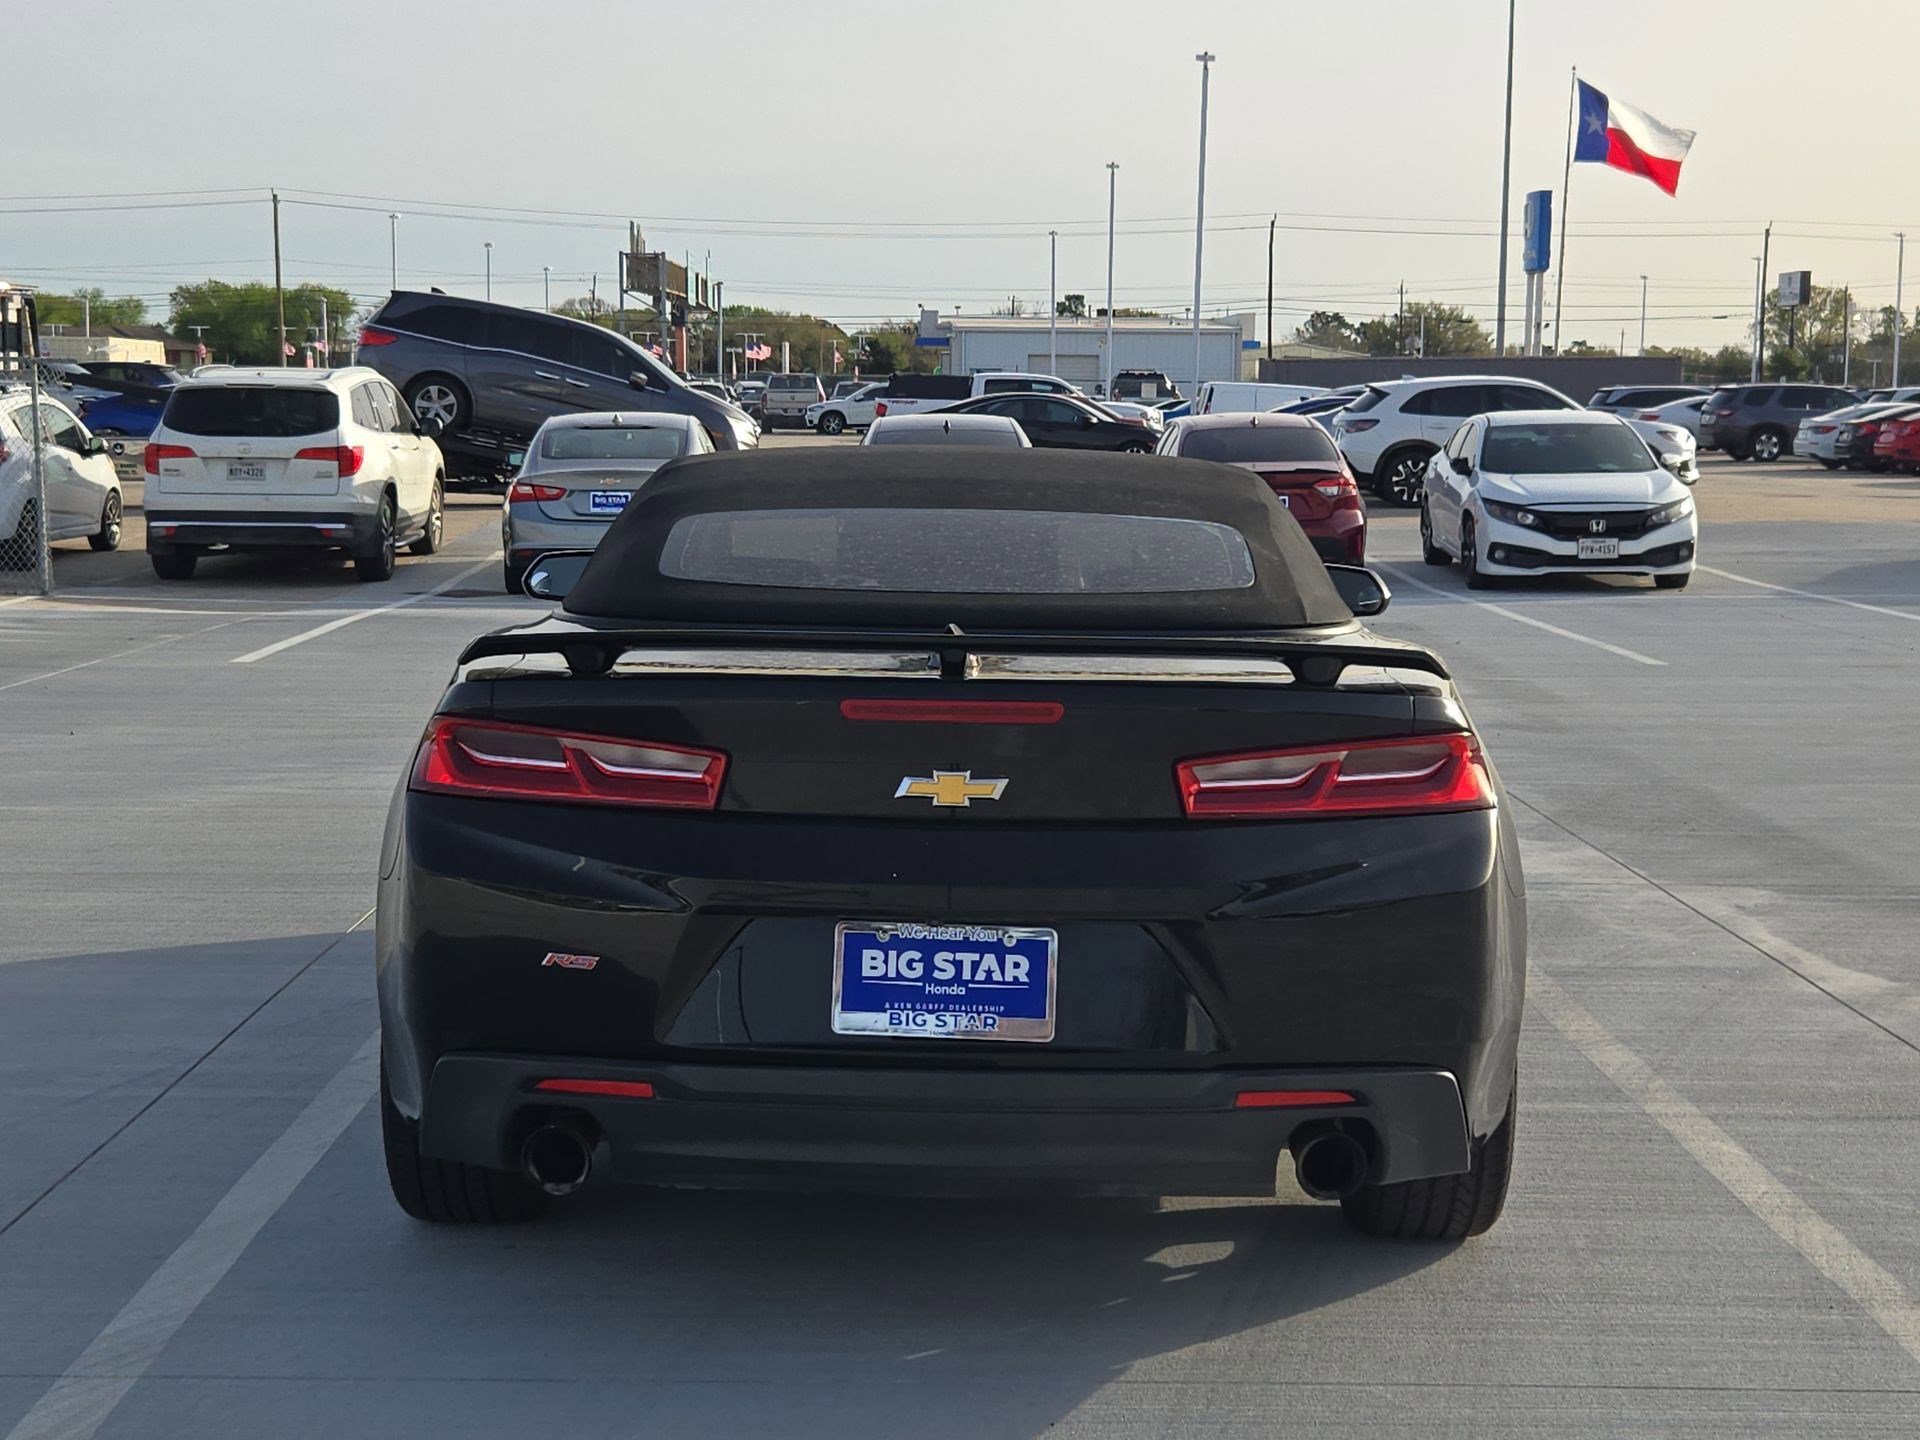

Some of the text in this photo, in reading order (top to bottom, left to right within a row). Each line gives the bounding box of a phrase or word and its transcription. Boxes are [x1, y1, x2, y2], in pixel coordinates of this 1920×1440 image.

[897, 923, 998, 942] We Hear You
[541, 952, 601, 970] RS
[862, 949, 1030, 983] BIG STAR
[925, 984, 966, 996] Honda
[894, 1002, 912, 1010] KEN
[916, 1003, 945, 1011] GARFF
[948, 1004, 1005, 1013] DEALERSHIP
[888, 1011, 998, 1031] BIG STAR
